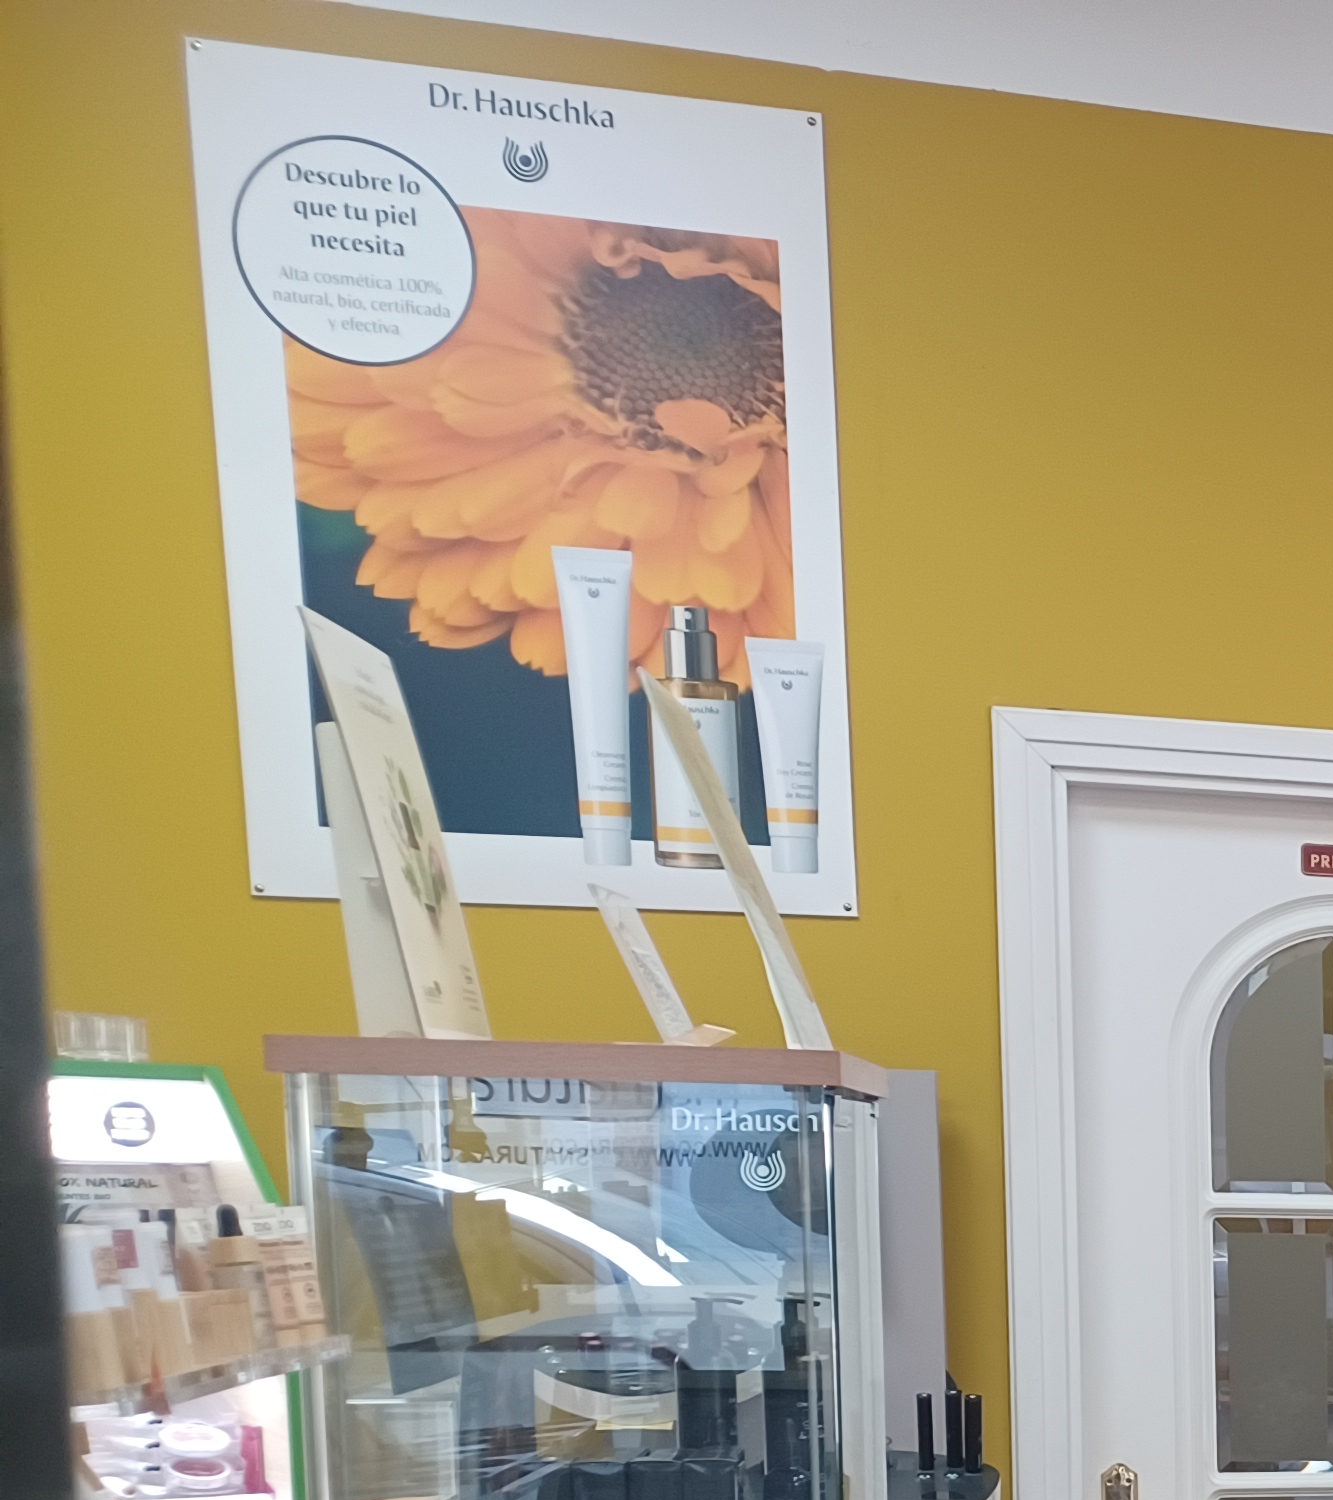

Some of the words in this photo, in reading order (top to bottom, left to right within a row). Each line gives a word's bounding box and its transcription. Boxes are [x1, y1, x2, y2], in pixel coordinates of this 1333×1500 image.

[428, 82, 468, 111] Dr.
[474, 88, 615, 129] Hauschka
[285, 162, 392, 193] Descubre
[399, 175, 421, 195] lo
[293, 201, 336, 220] que
[344, 203, 367, 222] tu
[375, 207, 417, 227] piel
[310, 233, 405, 257] necesita
[278, 265, 309, 282] Alta
[313, 270, 392, 291] cosmética
[398, 278, 443, 296] 100%
[272, 290, 333, 308] natural,
[337, 295, 366, 311] bio,
[370, 298, 451, 318] certificada
[328, 318, 337, 331] y
[341, 317, 400, 336] efectiva
[671, 1106, 711, 1133] Dr.
[86, 1178, 158, 1188] NATURAL
